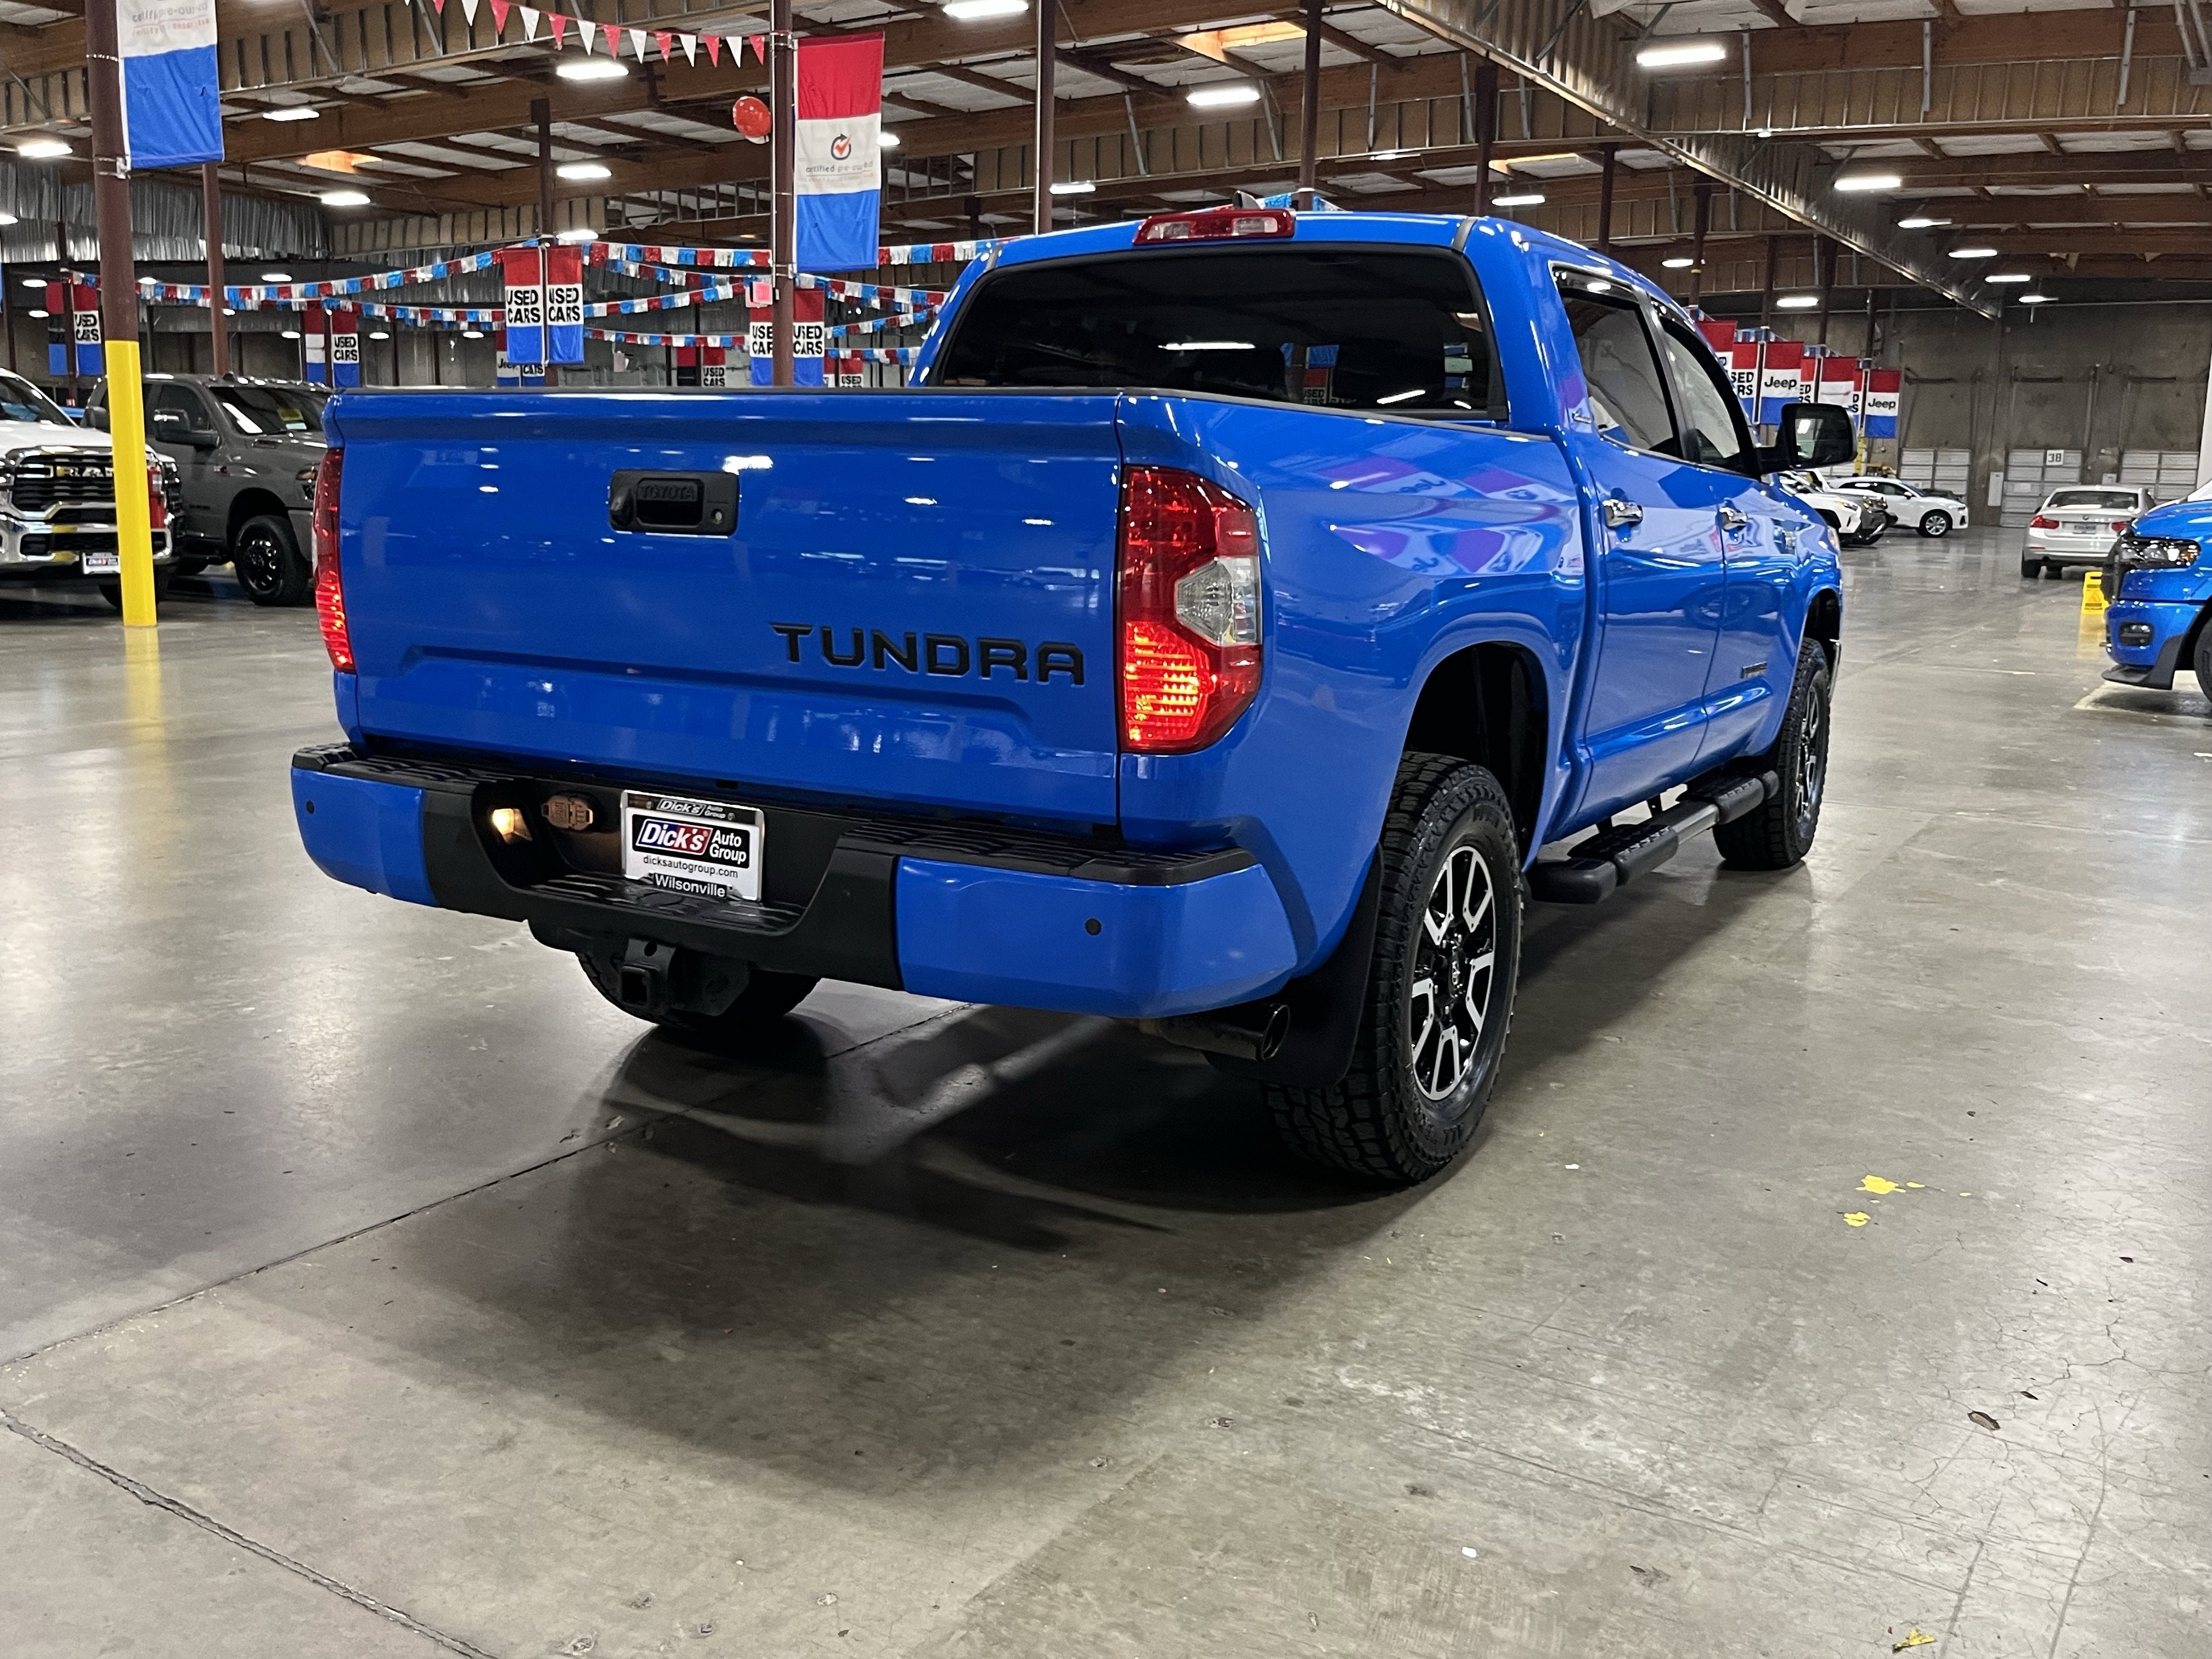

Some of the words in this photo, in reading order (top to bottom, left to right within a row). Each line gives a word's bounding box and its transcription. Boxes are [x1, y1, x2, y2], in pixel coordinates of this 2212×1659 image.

[506, 290, 538, 306] USED
[549, 287, 579, 304] USED
[75, 314, 97, 327] USED
[507, 307, 540, 323] CARS
[549, 306, 580, 322] CARS
[753, 325, 772, 340] USE
[793, 325, 822, 340] USED
[334, 336, 356, 348] USED
[794, 341, 822, 354] CARS
[703, 367, 725, 377] USED
[1731, 372, 1754, 383] SED
[842, 376, 861, 385] USED
[1764, 376, 1797, 390] Jeep
[1737, 385, 1753, 395] RS
[1800, 385, 1811, 394] ED
[1868, 398, 1896, 410] Jeep
[2048, 453, 2062, 462] 38
[771, 623, 1085, 687] TUNDRA
[660, 800, 701, 813] Dick's
[641, 823, 705, 850] Dick's
[712, 830, 742, 847] Auto
[710, 843, 747, 865] Group
[643, 855, 738, 878] dicksautogroup.com
[654, 873, 726, 897] Wilsonville
